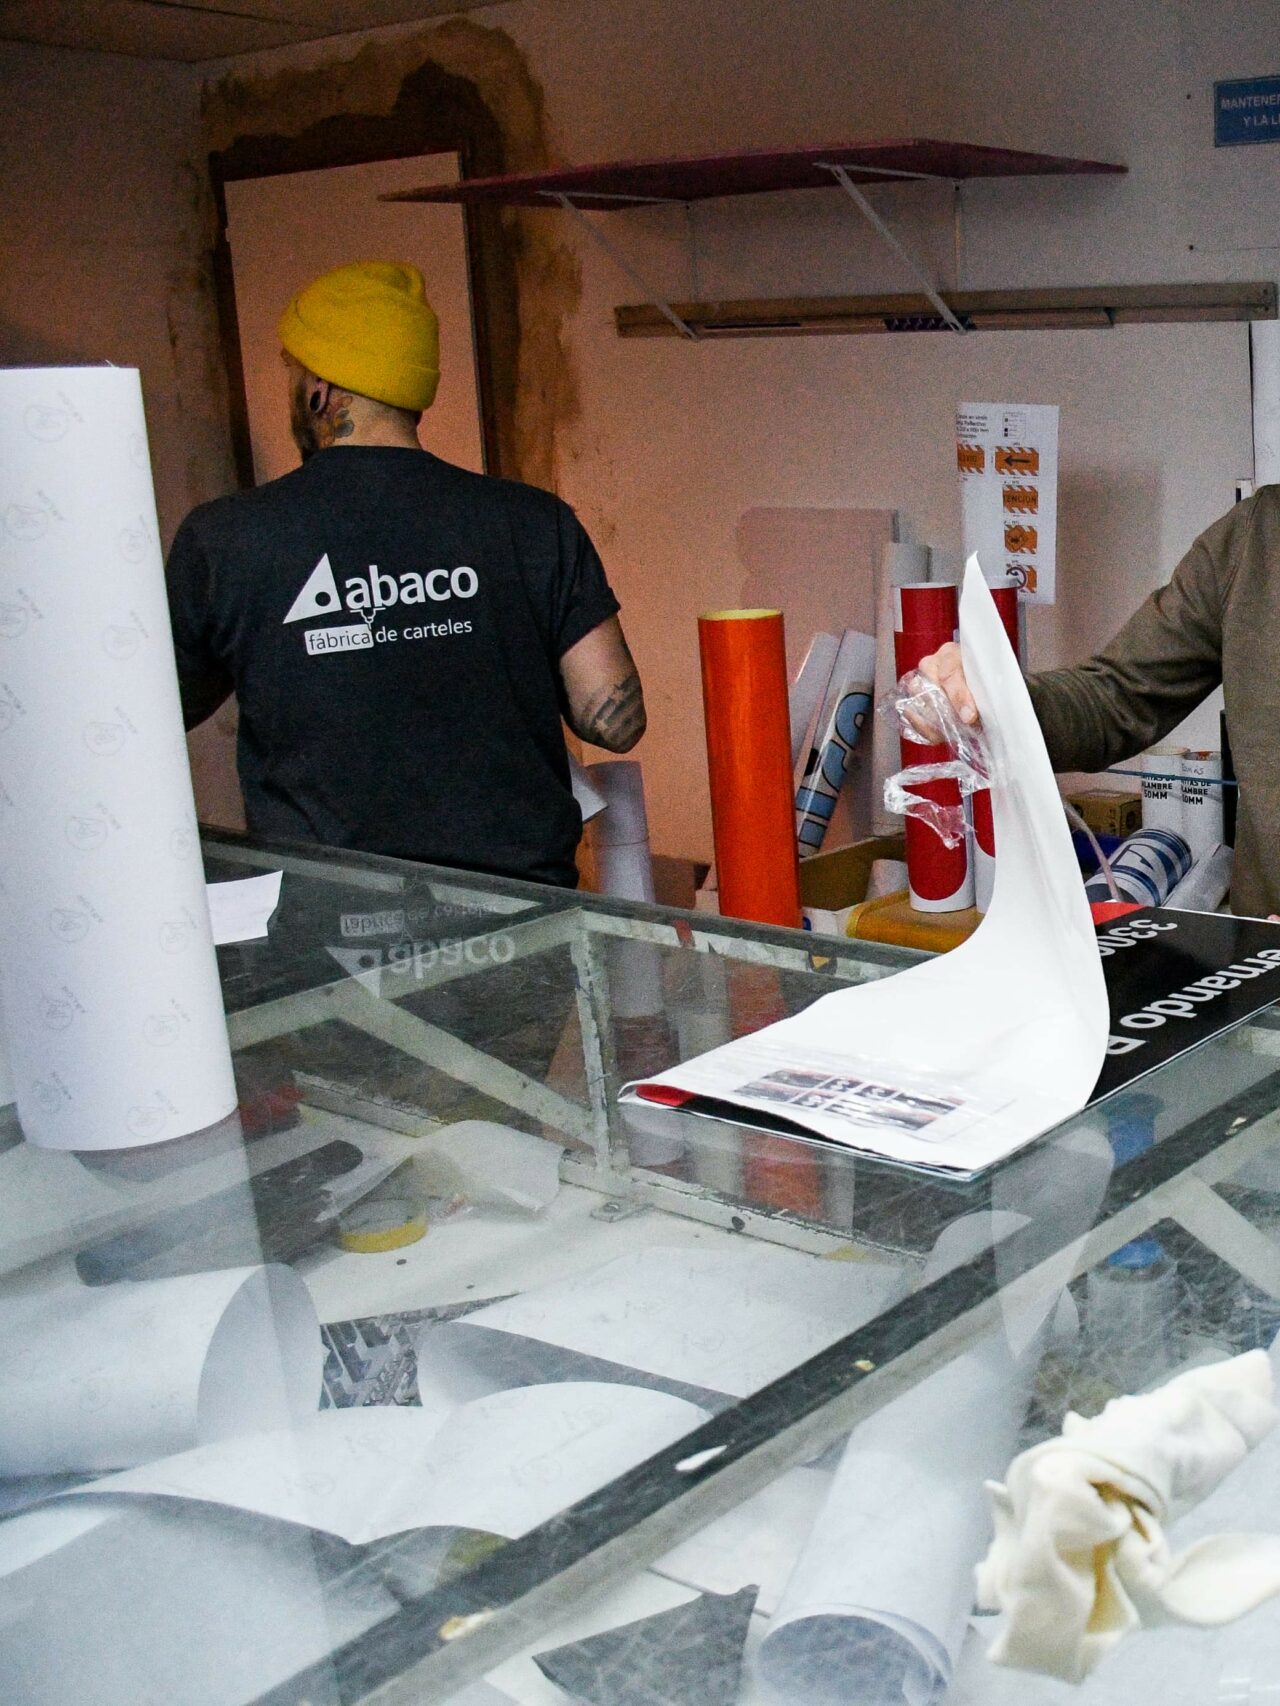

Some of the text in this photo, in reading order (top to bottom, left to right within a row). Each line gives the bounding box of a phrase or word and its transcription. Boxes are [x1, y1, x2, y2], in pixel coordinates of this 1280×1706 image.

[1243, 116, 1251, 127] Y
[1253, 115, 1268, 126] LA
[345, 564, 479, 610] abaco
[308, 618, 473, 651] fábrica de carteles
